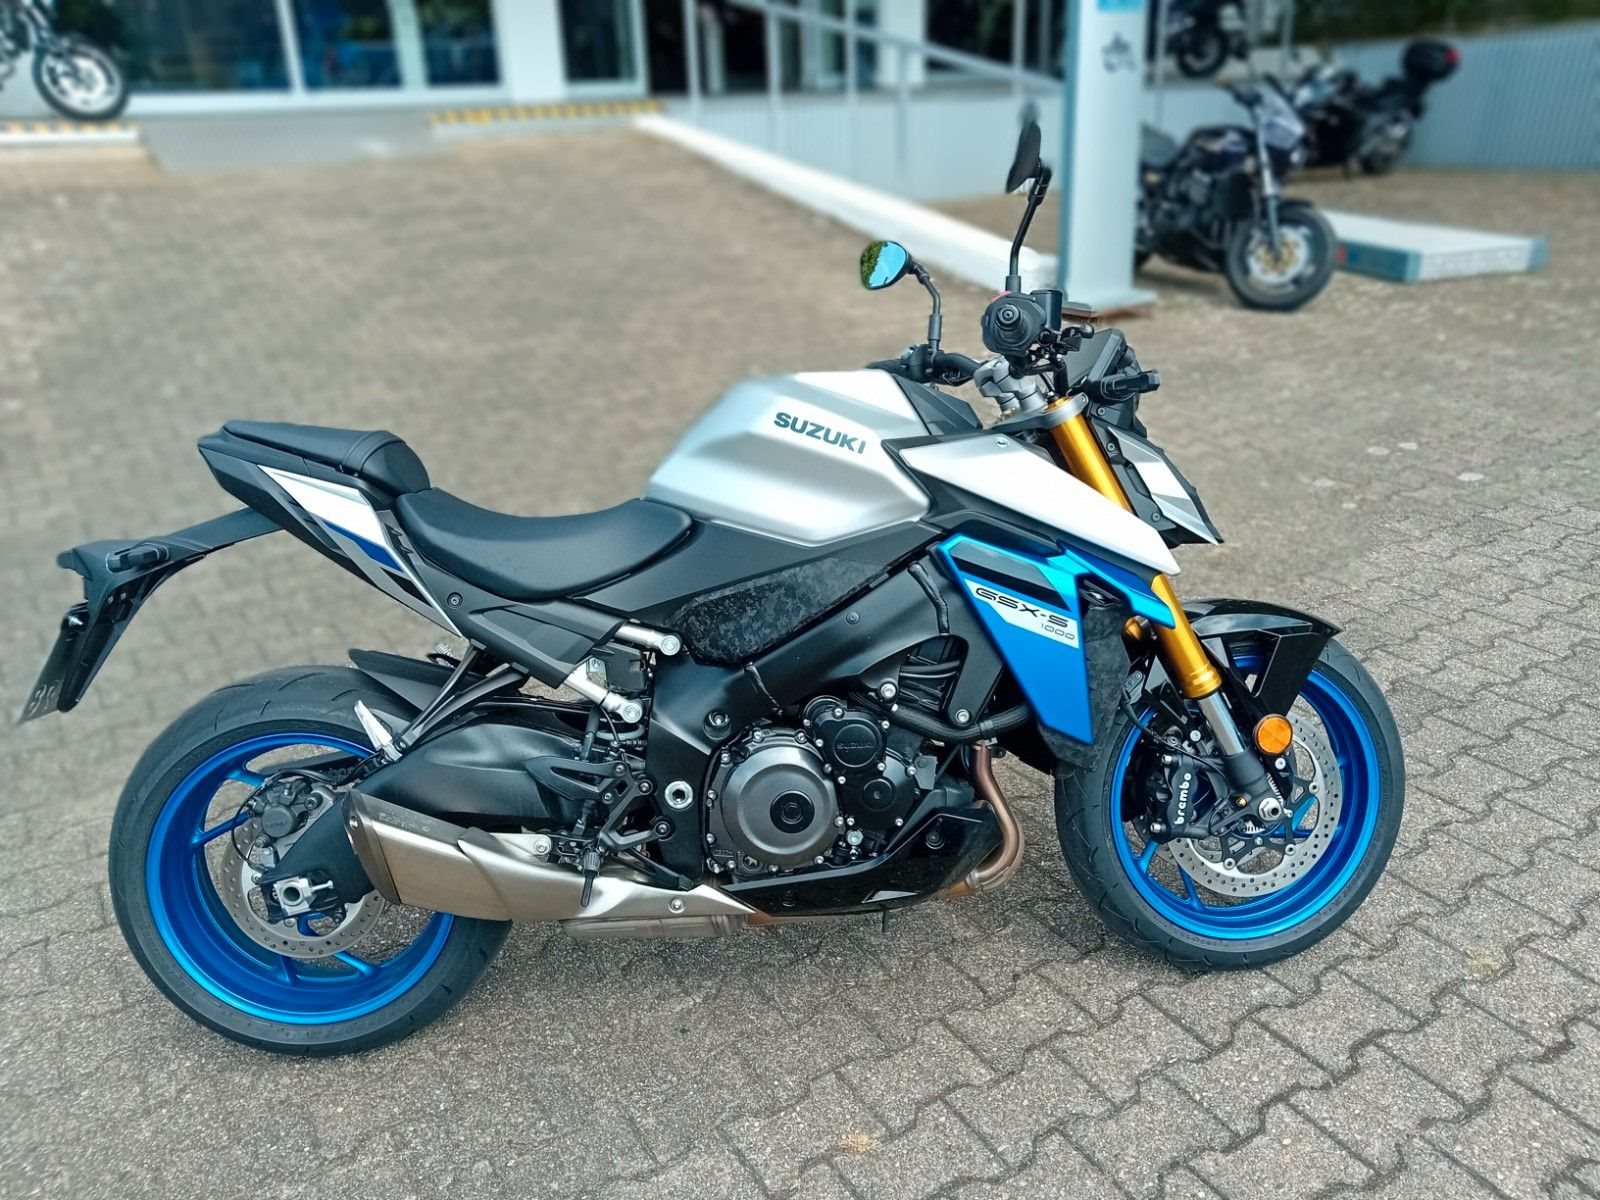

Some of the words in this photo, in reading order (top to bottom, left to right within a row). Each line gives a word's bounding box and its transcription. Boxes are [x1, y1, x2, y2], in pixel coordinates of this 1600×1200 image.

[773, 412, 866, 454] SUZUKI
[976, 588, 1068, 628] GSX-S
[1041, 623, 1075, 640] 1000
[1174, 772, 1192, 825] brembo
